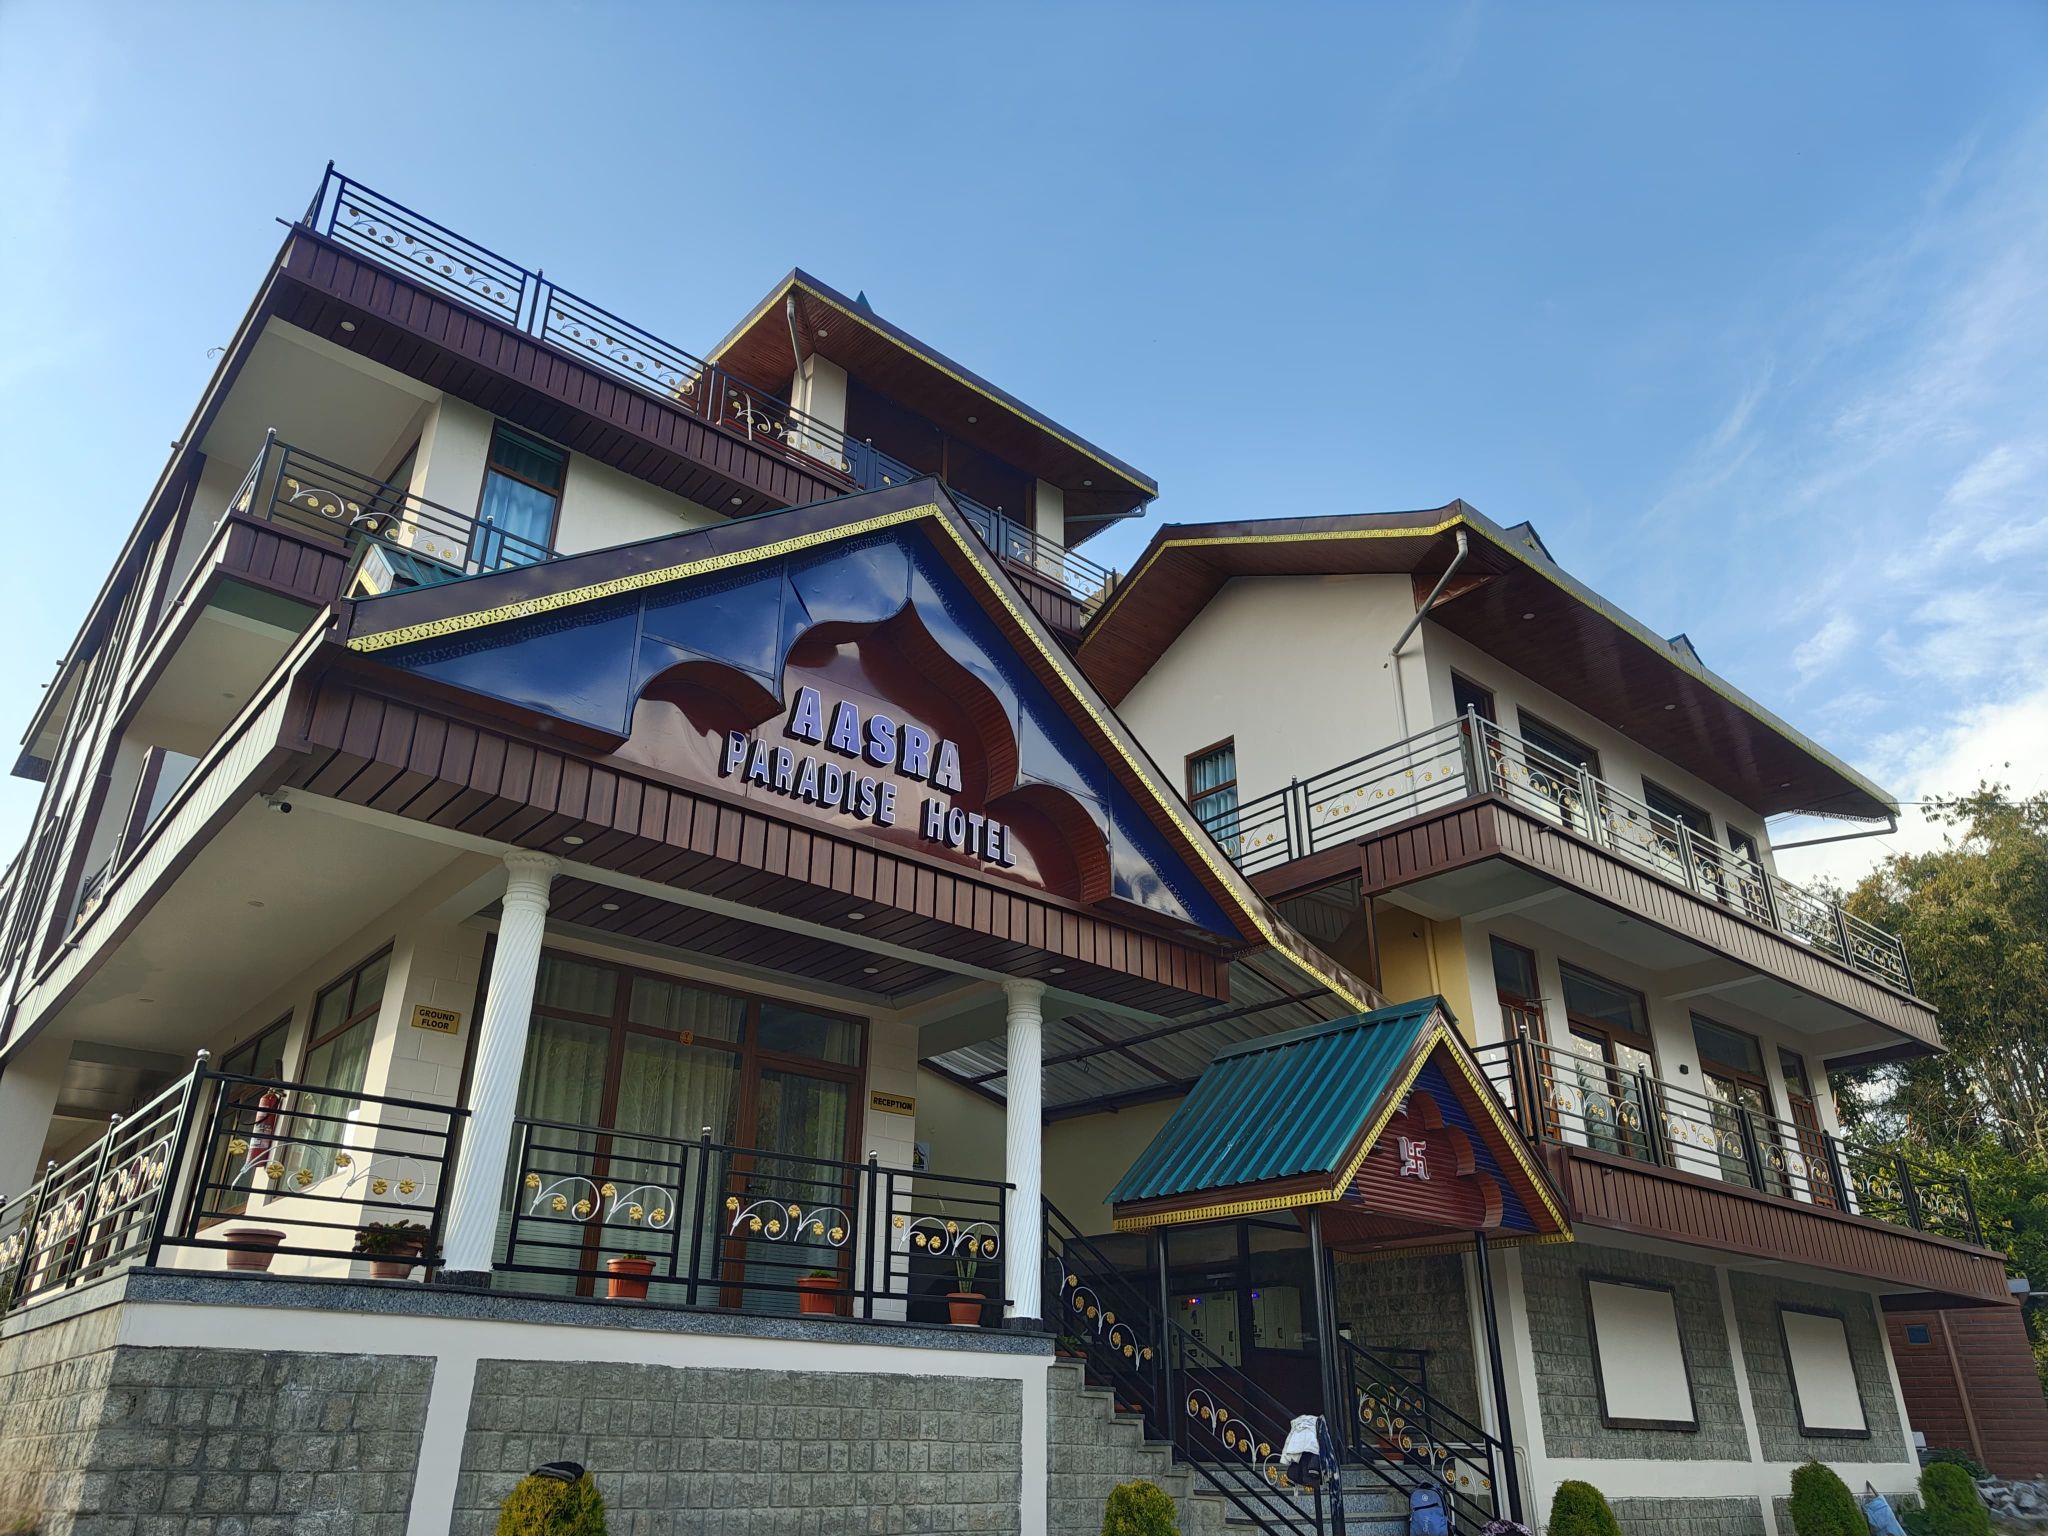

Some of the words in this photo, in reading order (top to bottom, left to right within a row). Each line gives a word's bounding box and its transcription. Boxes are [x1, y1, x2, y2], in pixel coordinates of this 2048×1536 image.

[785, 685, 962, 793] AASRA
[719, 730, 898, 828] PARADISE
[920, 797, 1017, 867] HOTEL
[419, 1009, 455, 1021] GROUND
[421, 1018, 449, 1029] FLOOR
[873, 1096, 912, 1110] RECEPTION
